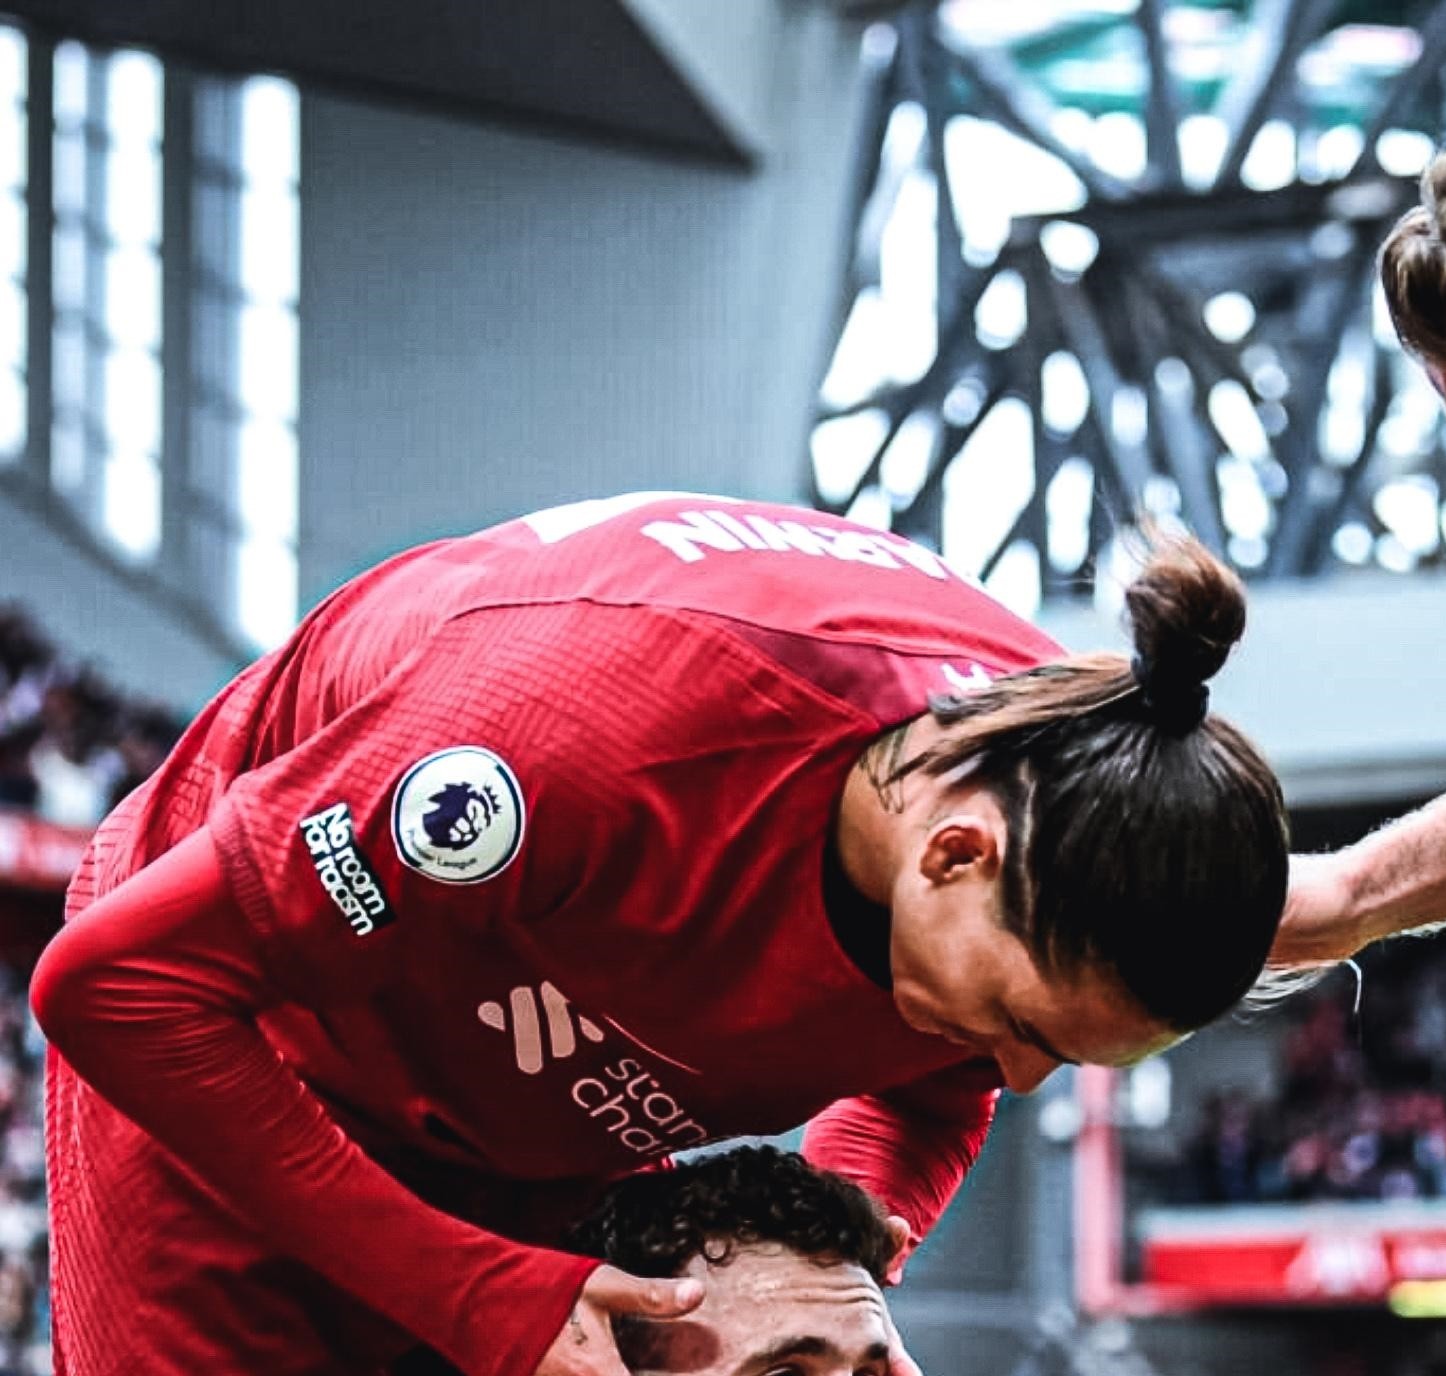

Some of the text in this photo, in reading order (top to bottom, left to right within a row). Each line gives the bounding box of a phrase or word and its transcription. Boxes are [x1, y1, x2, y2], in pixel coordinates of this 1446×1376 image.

[325, 802, 386, 917] No room
[604, 1058, 708, 1145] stan
